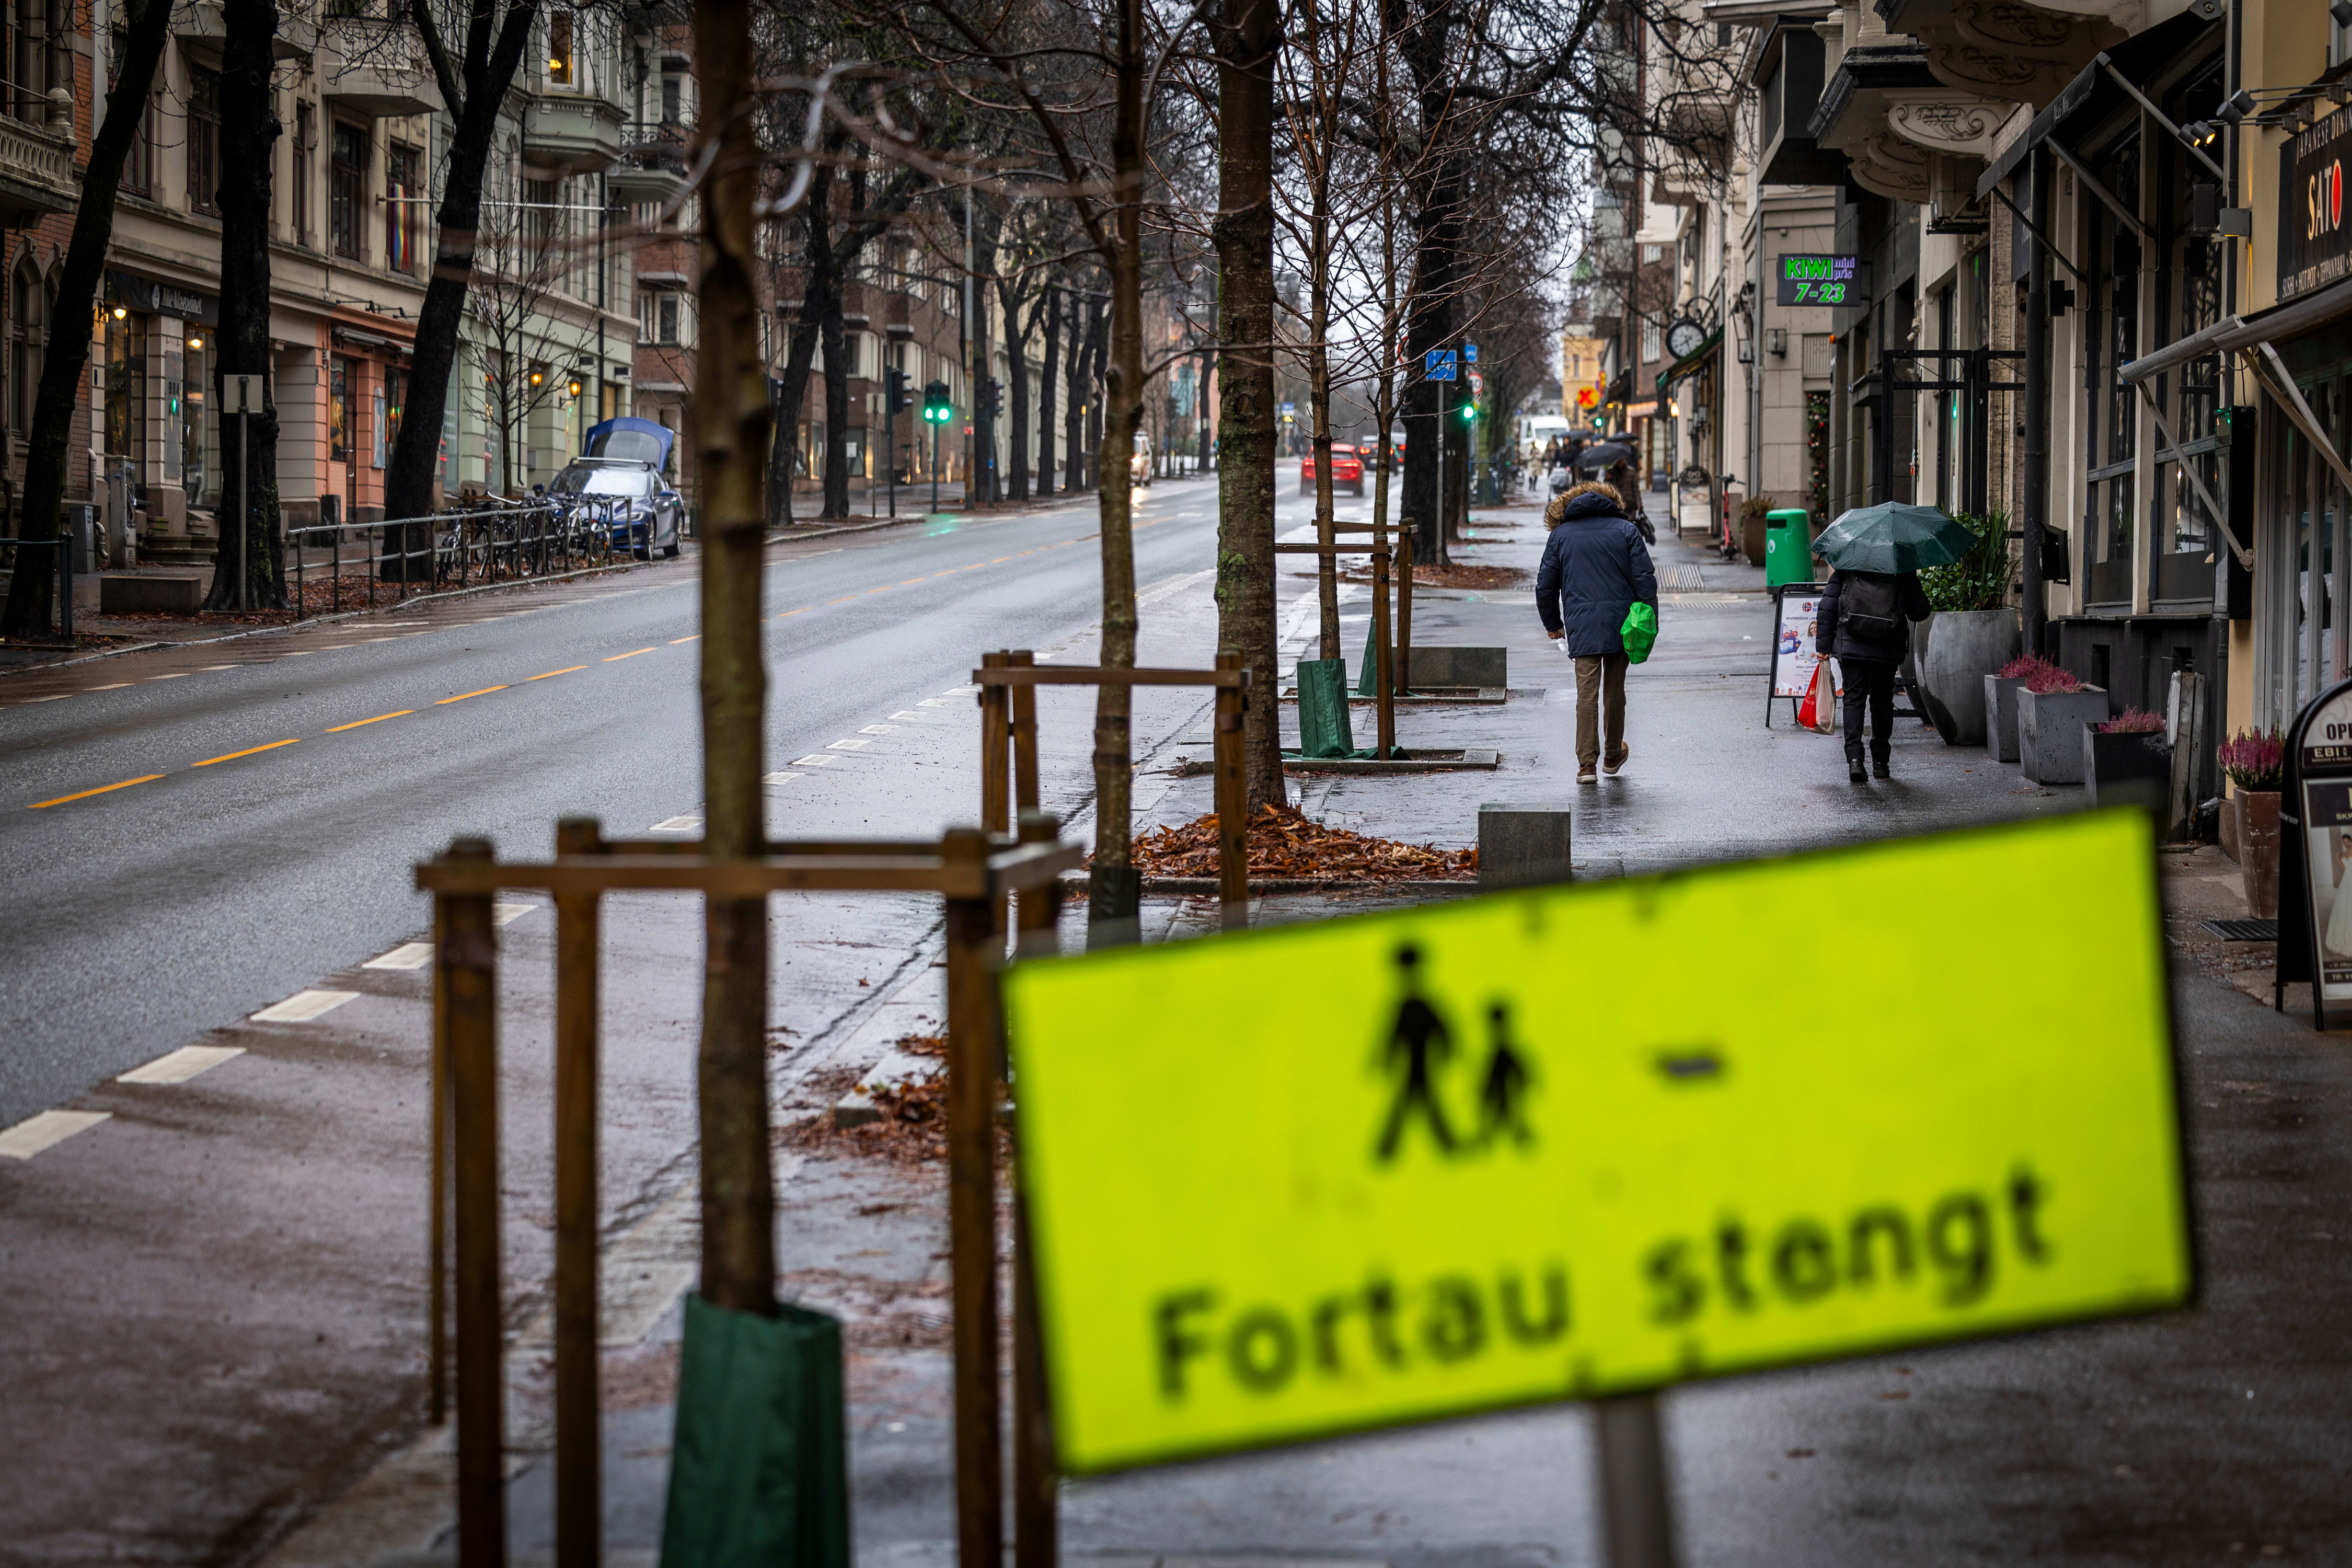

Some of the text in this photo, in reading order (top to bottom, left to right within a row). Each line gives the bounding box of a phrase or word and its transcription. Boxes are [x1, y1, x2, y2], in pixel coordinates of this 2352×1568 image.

[2297, 120, 2328, 165] JAPANESE
[2308, 158, 2342, 240] SATO
[1785, 258, 1833, 280] KIWI
[1834, 258, 1854, 268] mini
[1834, 268, 1852, 281] pris
[2283, 275, 2295, 298] SUSHI
[2299, 270, 2307, 292] HOT
[2308, 266, 2316, 289] POT
[2320, 254, 2345, 283] TEPPANYAKI
[1794, 283, 1845, 303] 7-23
[2275, 688, 2283, 710] SAT
[2314, 746, 2339, 757] EBI
[1152, 1167, 2054, 1401] Fortau stengt
